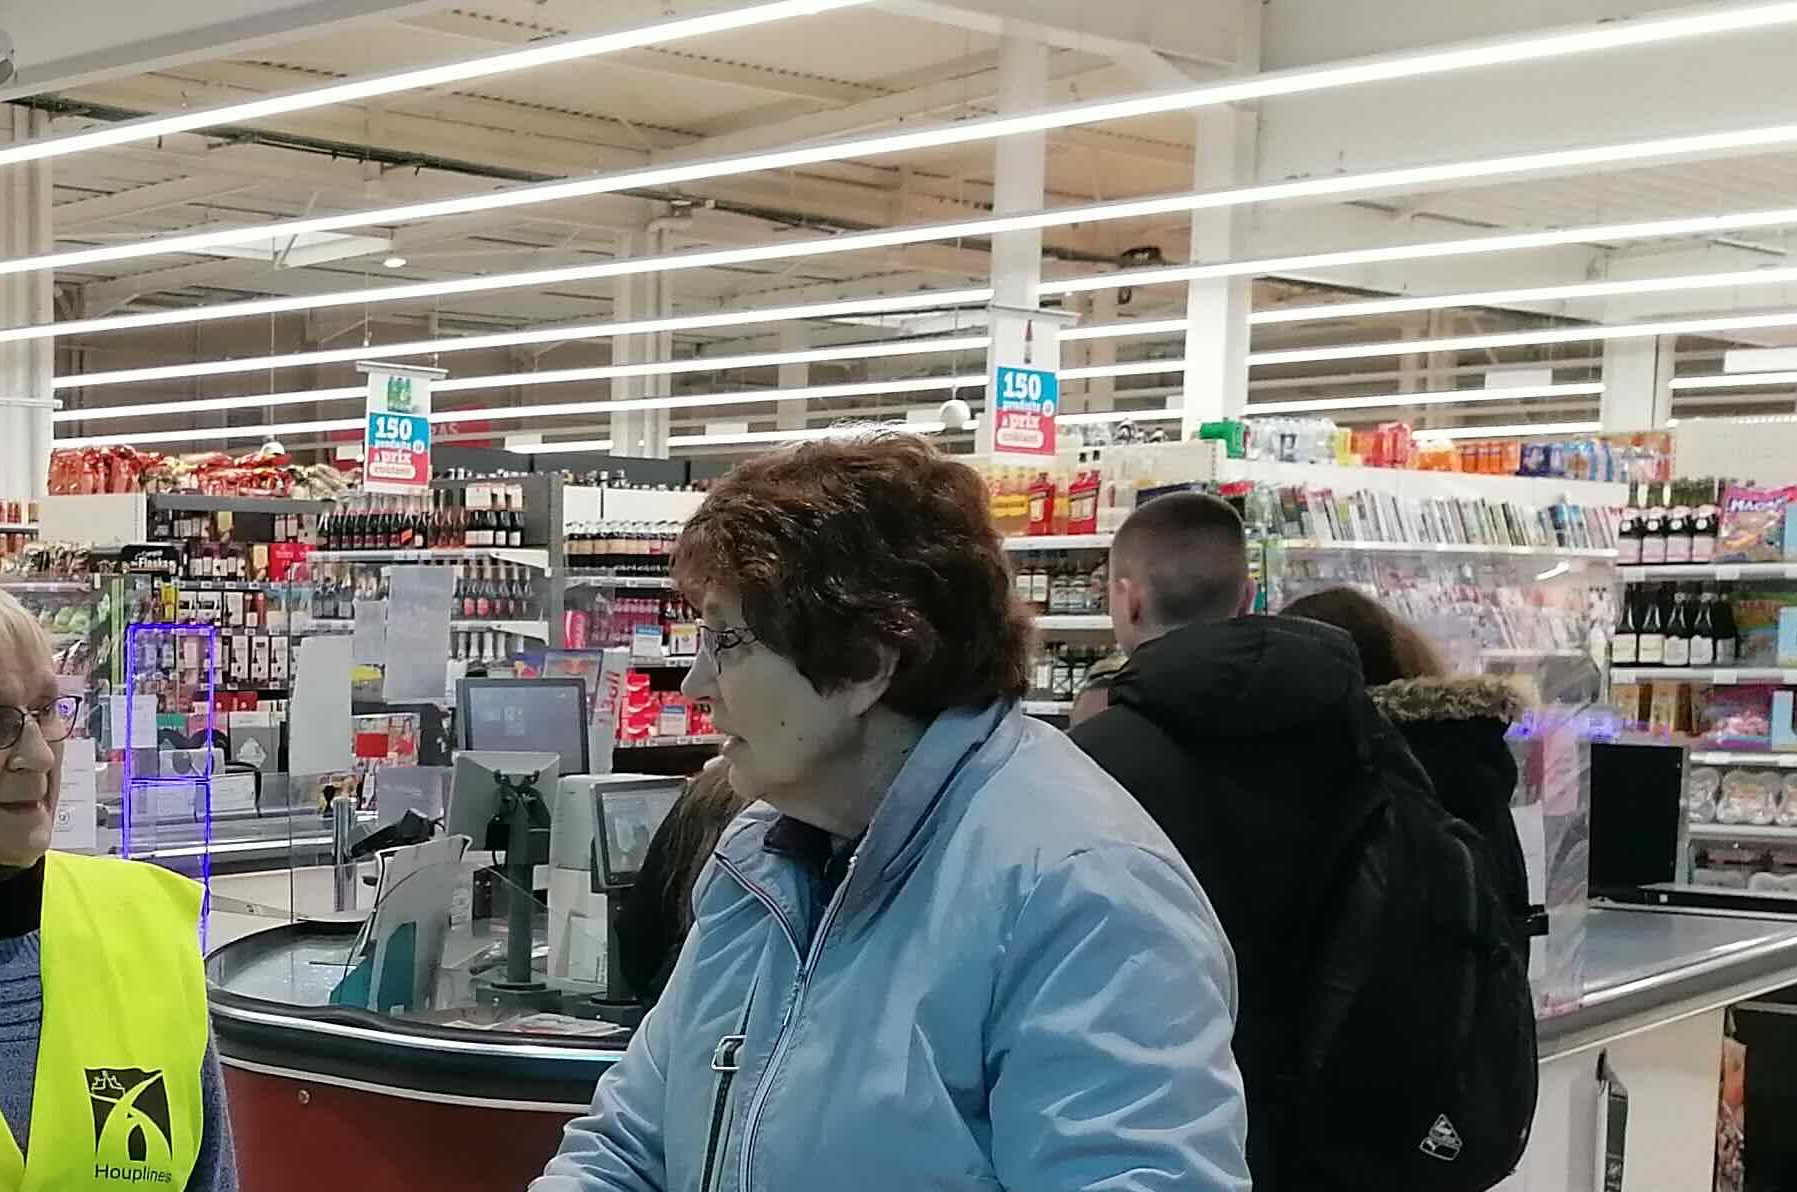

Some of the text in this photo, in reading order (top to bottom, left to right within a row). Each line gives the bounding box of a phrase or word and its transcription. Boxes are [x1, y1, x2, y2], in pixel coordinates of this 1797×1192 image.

[1002, 371, 1042, 401] 150
[374, 416, 413, 441] 150
[94, 1163, 172, 1183] Houplines
